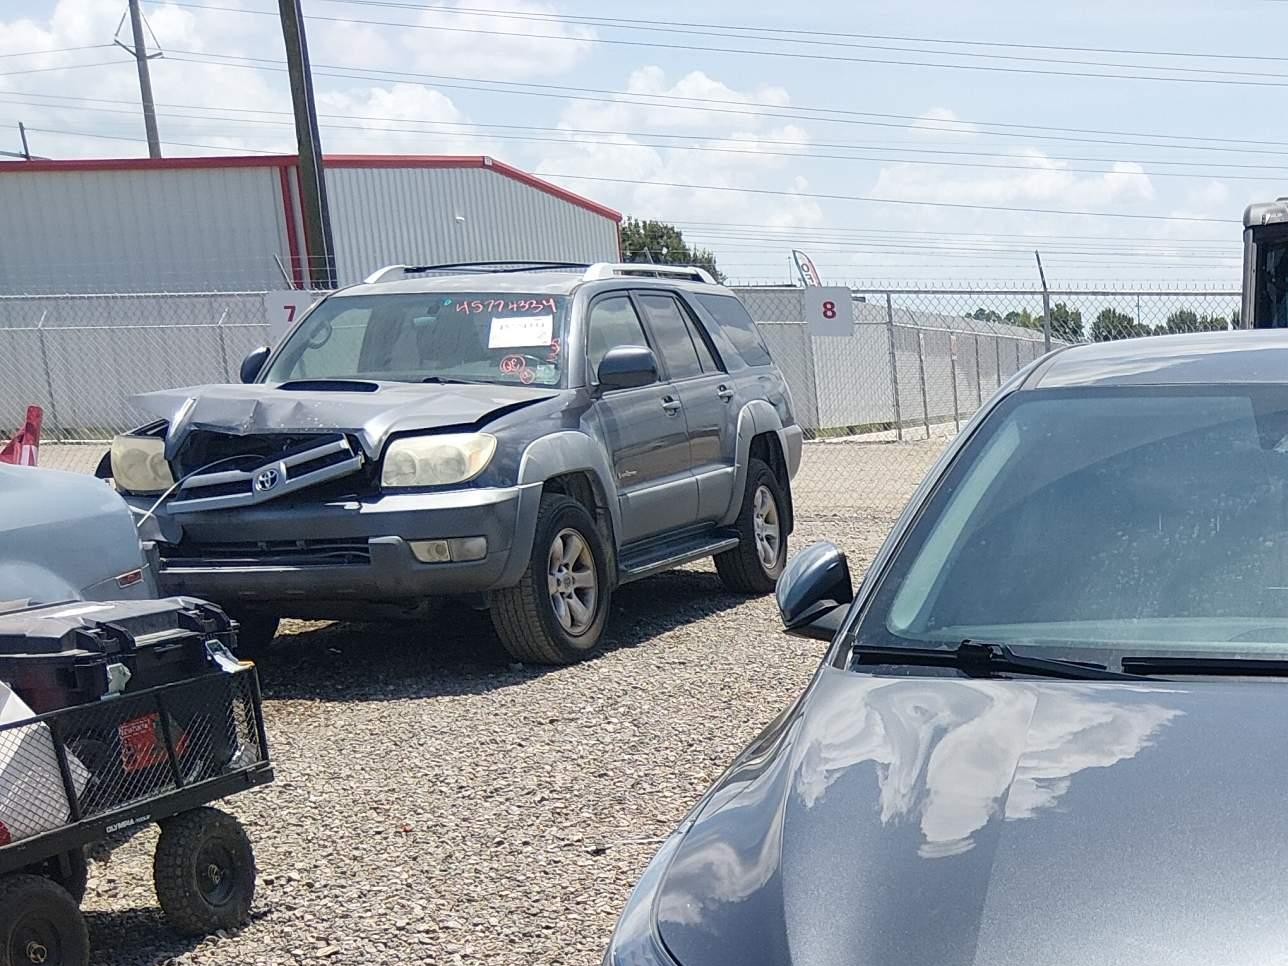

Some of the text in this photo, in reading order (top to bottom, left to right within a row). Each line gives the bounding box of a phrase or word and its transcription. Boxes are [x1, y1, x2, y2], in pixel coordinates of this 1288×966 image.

[283, 305, 296, 322] 7
[456, 298, 557, 315] 45774334
[822, 301, 837, 319] 8
